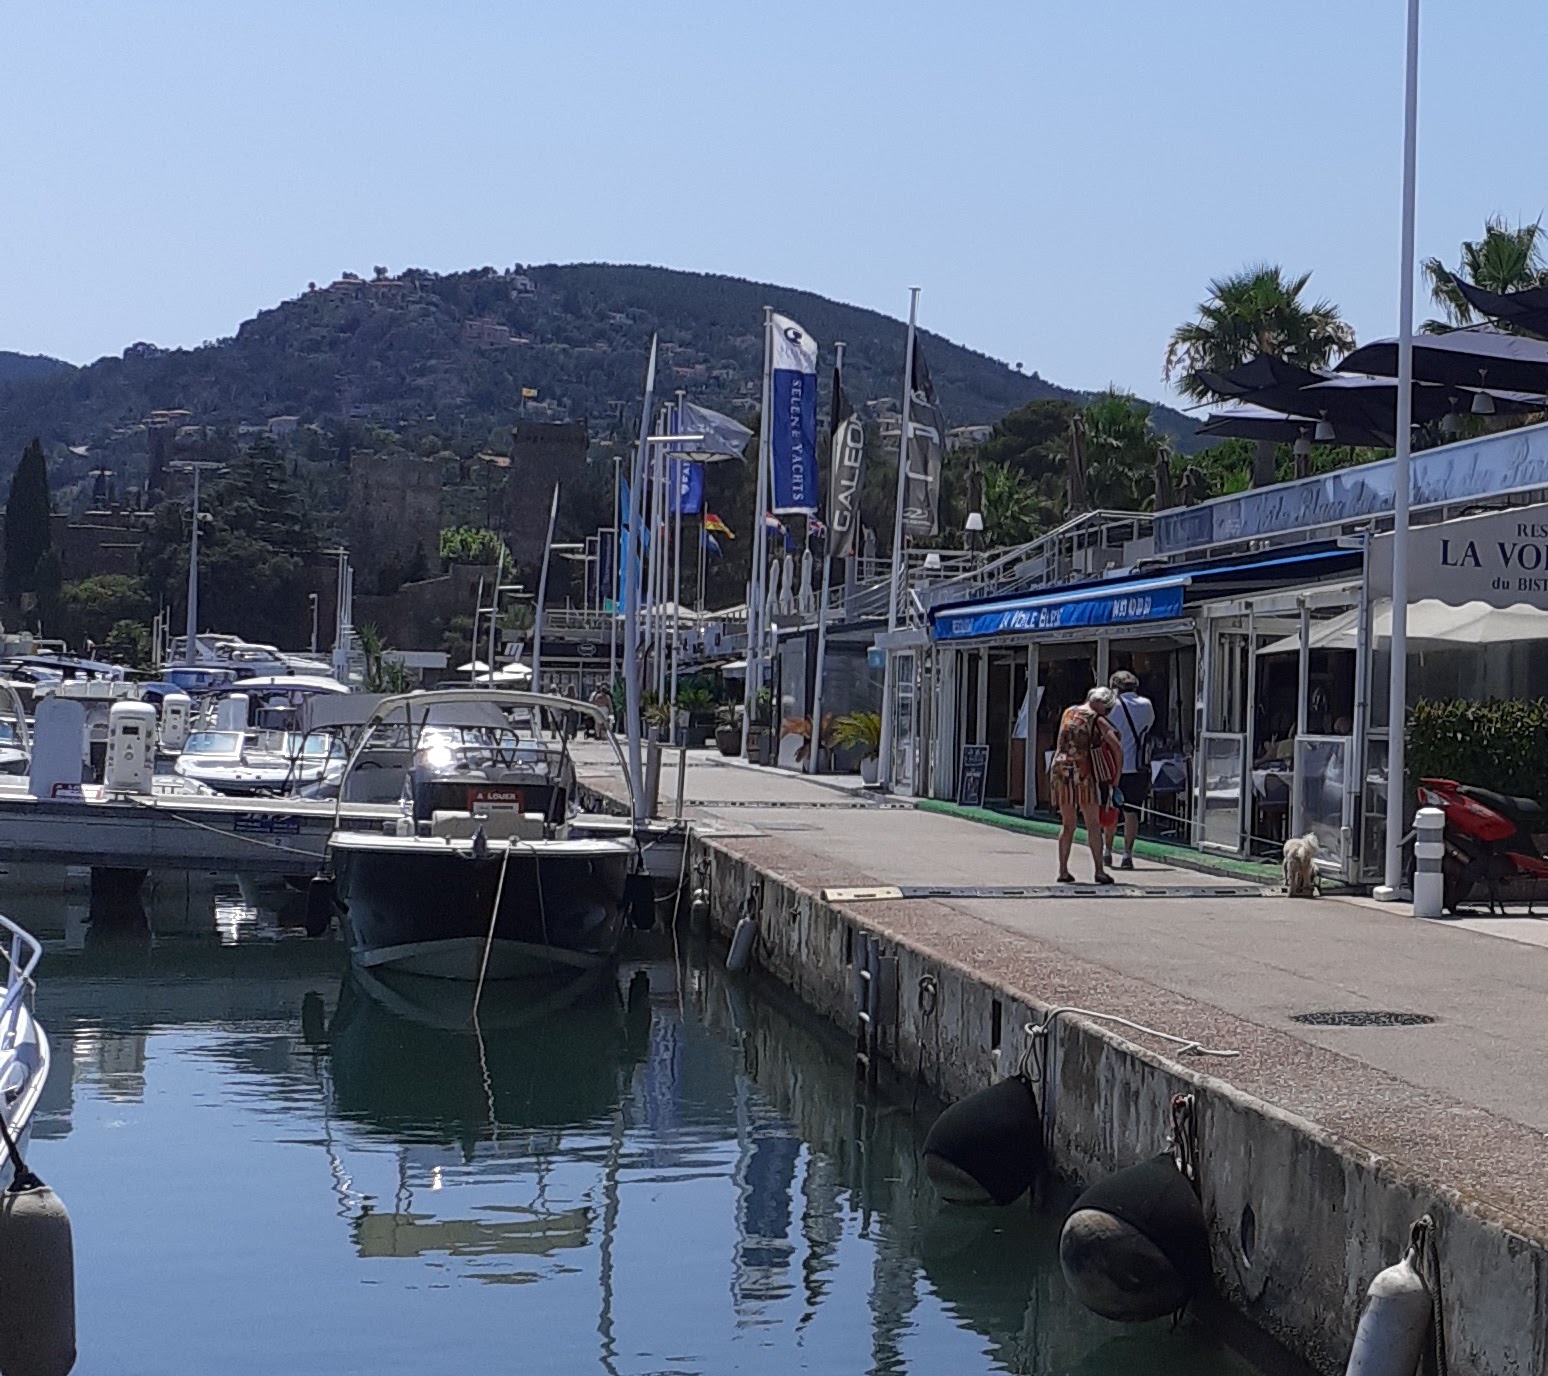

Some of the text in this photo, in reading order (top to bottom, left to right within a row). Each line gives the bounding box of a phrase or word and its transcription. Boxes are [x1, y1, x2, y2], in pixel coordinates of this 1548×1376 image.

[789, 378, 804, 501] SELENE YACHTS
[1440, 539, 1483, 568] LA
[1491, 576, 1511, 591] du
